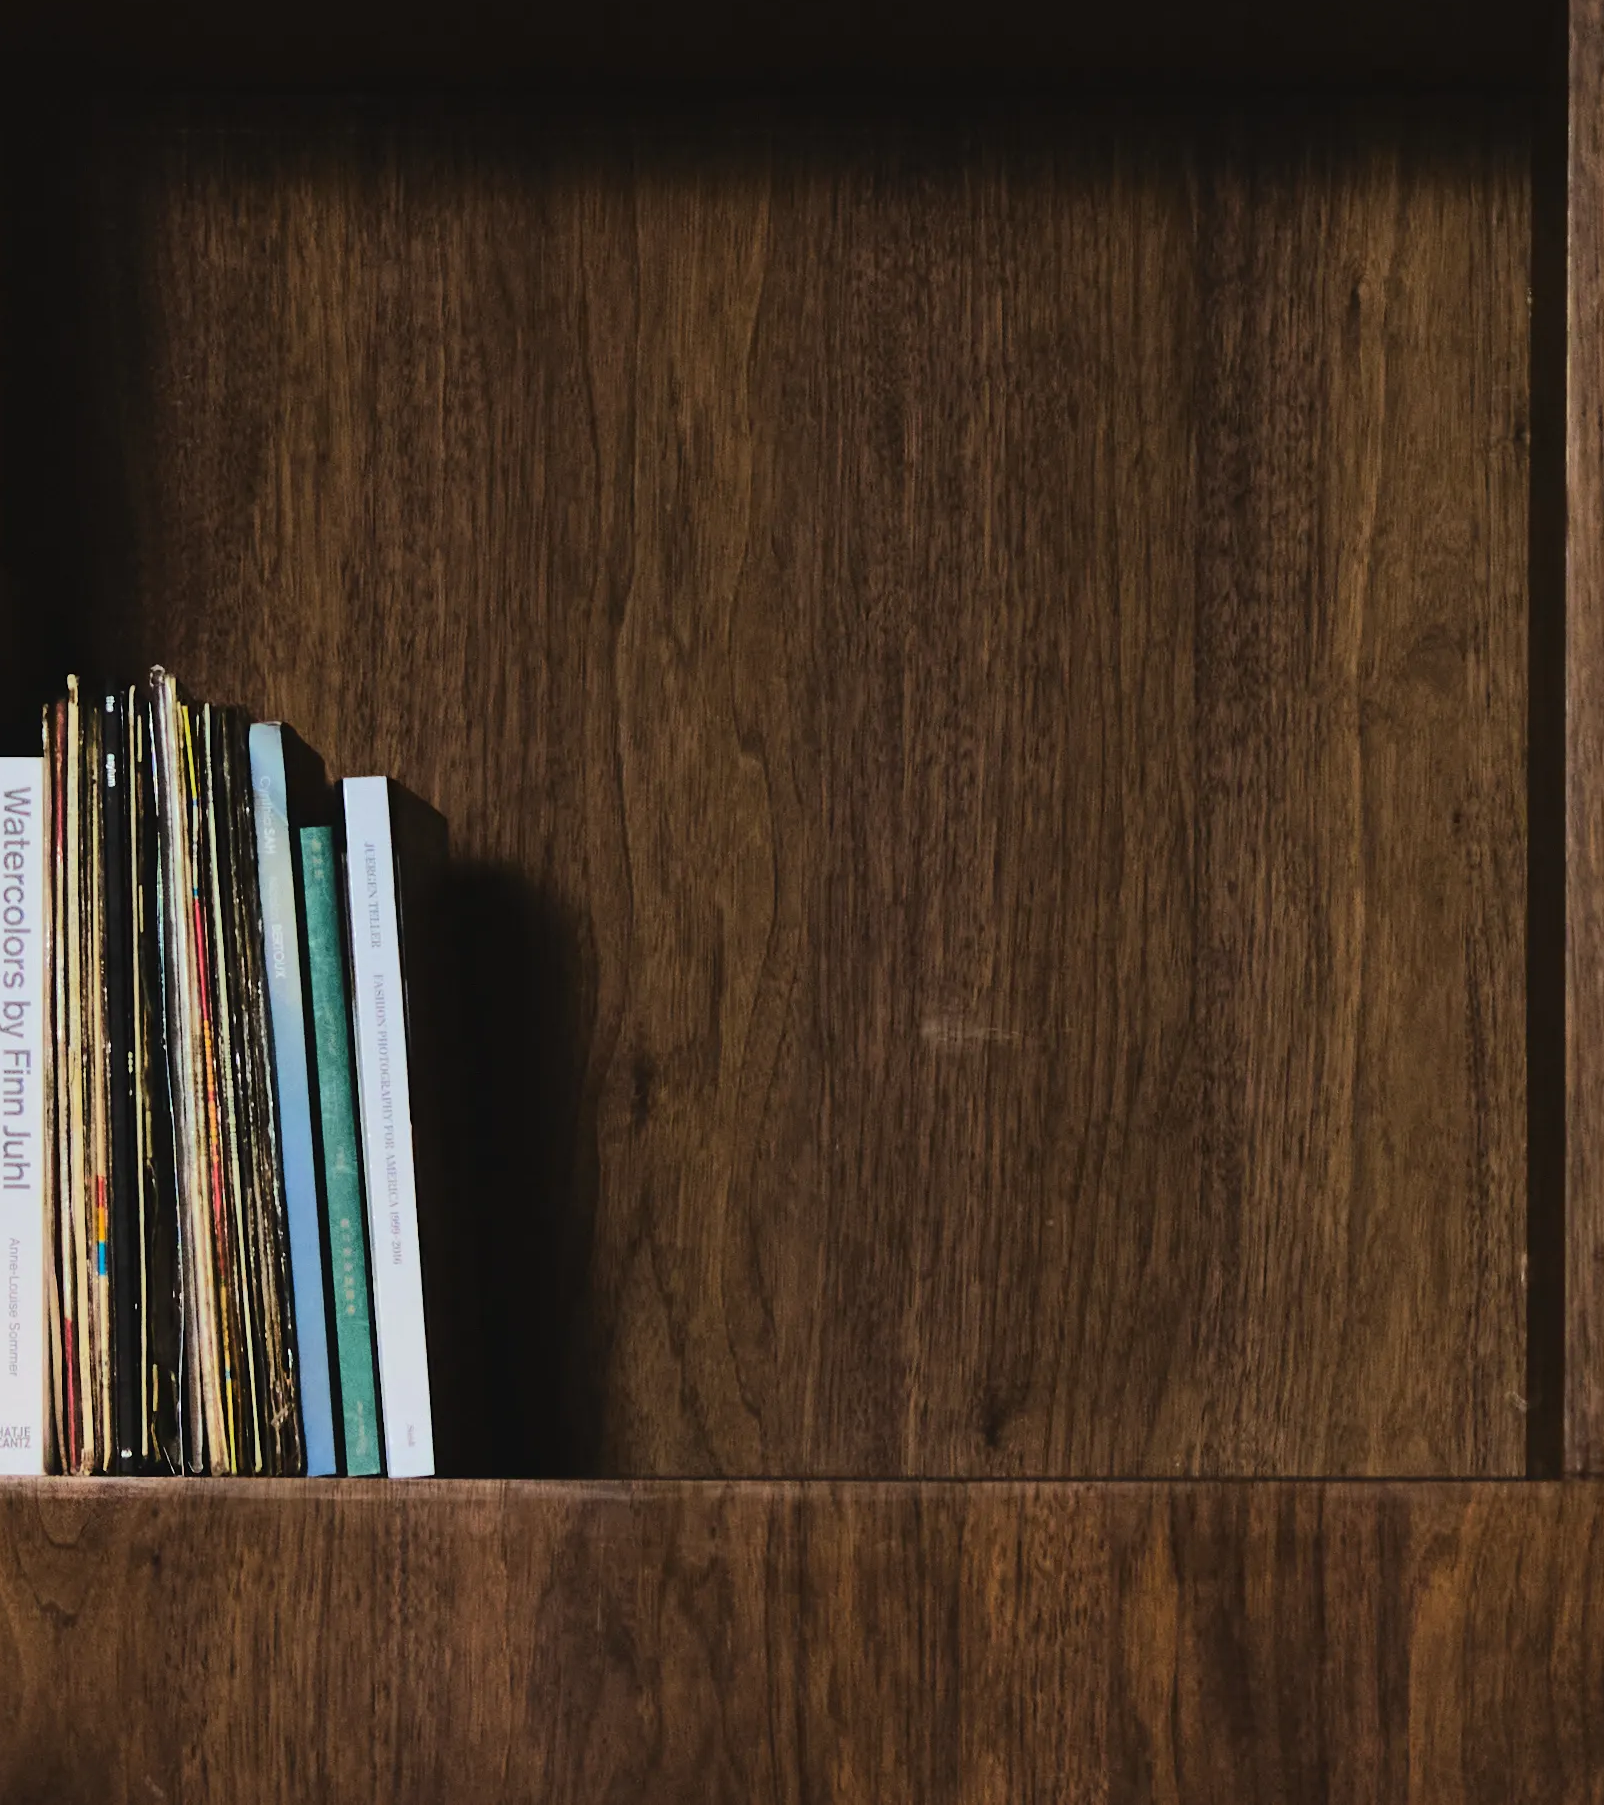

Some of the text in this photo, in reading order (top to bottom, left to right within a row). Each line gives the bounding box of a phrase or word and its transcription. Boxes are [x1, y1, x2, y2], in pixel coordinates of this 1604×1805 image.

[3, 786, 32, 990] Watercolors
[364, 842, 382, 949] JUERGEN TELLER
[373, 973, 387, 1028] FASHION
[3, 1048, 32, 1117] Finn
[377, 1031, 395, 1121] PHOTOGRAPHY
[3, 1126, 32, 1190] Juhl
[383, 1124, 395, 1150] FOR
[385, 1154, 400, 1209] AMERICA
[9, 1237, 21, 1378] Anne-Louise Sommer
